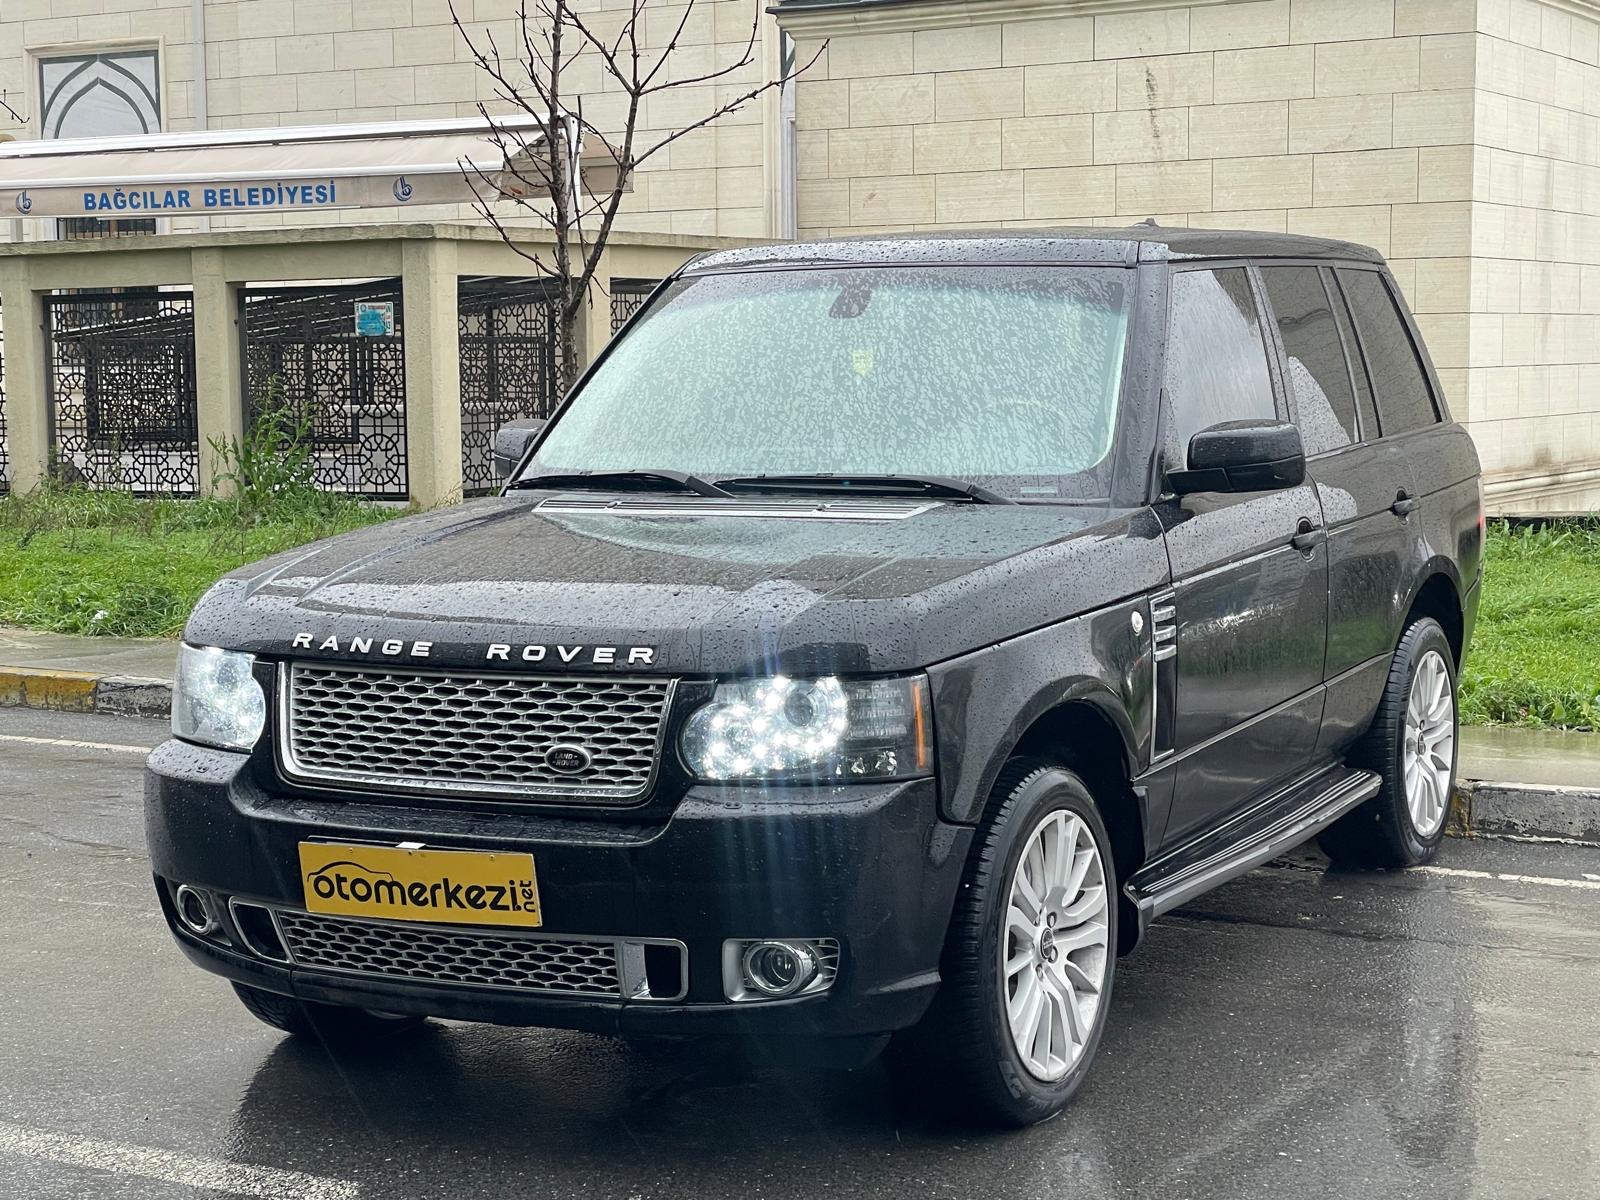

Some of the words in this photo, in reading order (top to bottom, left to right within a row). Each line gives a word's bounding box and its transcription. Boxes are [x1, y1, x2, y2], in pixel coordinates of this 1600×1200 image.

[83, 188, 191, 211] BAĞCILAR
[203, 180, 336, 208] BELEDİYESİ
[291, 632, 433, 657] RANGE
[485, 643, 654, 664] ROVER
[313, 873, 519, 911] otomerkezi
